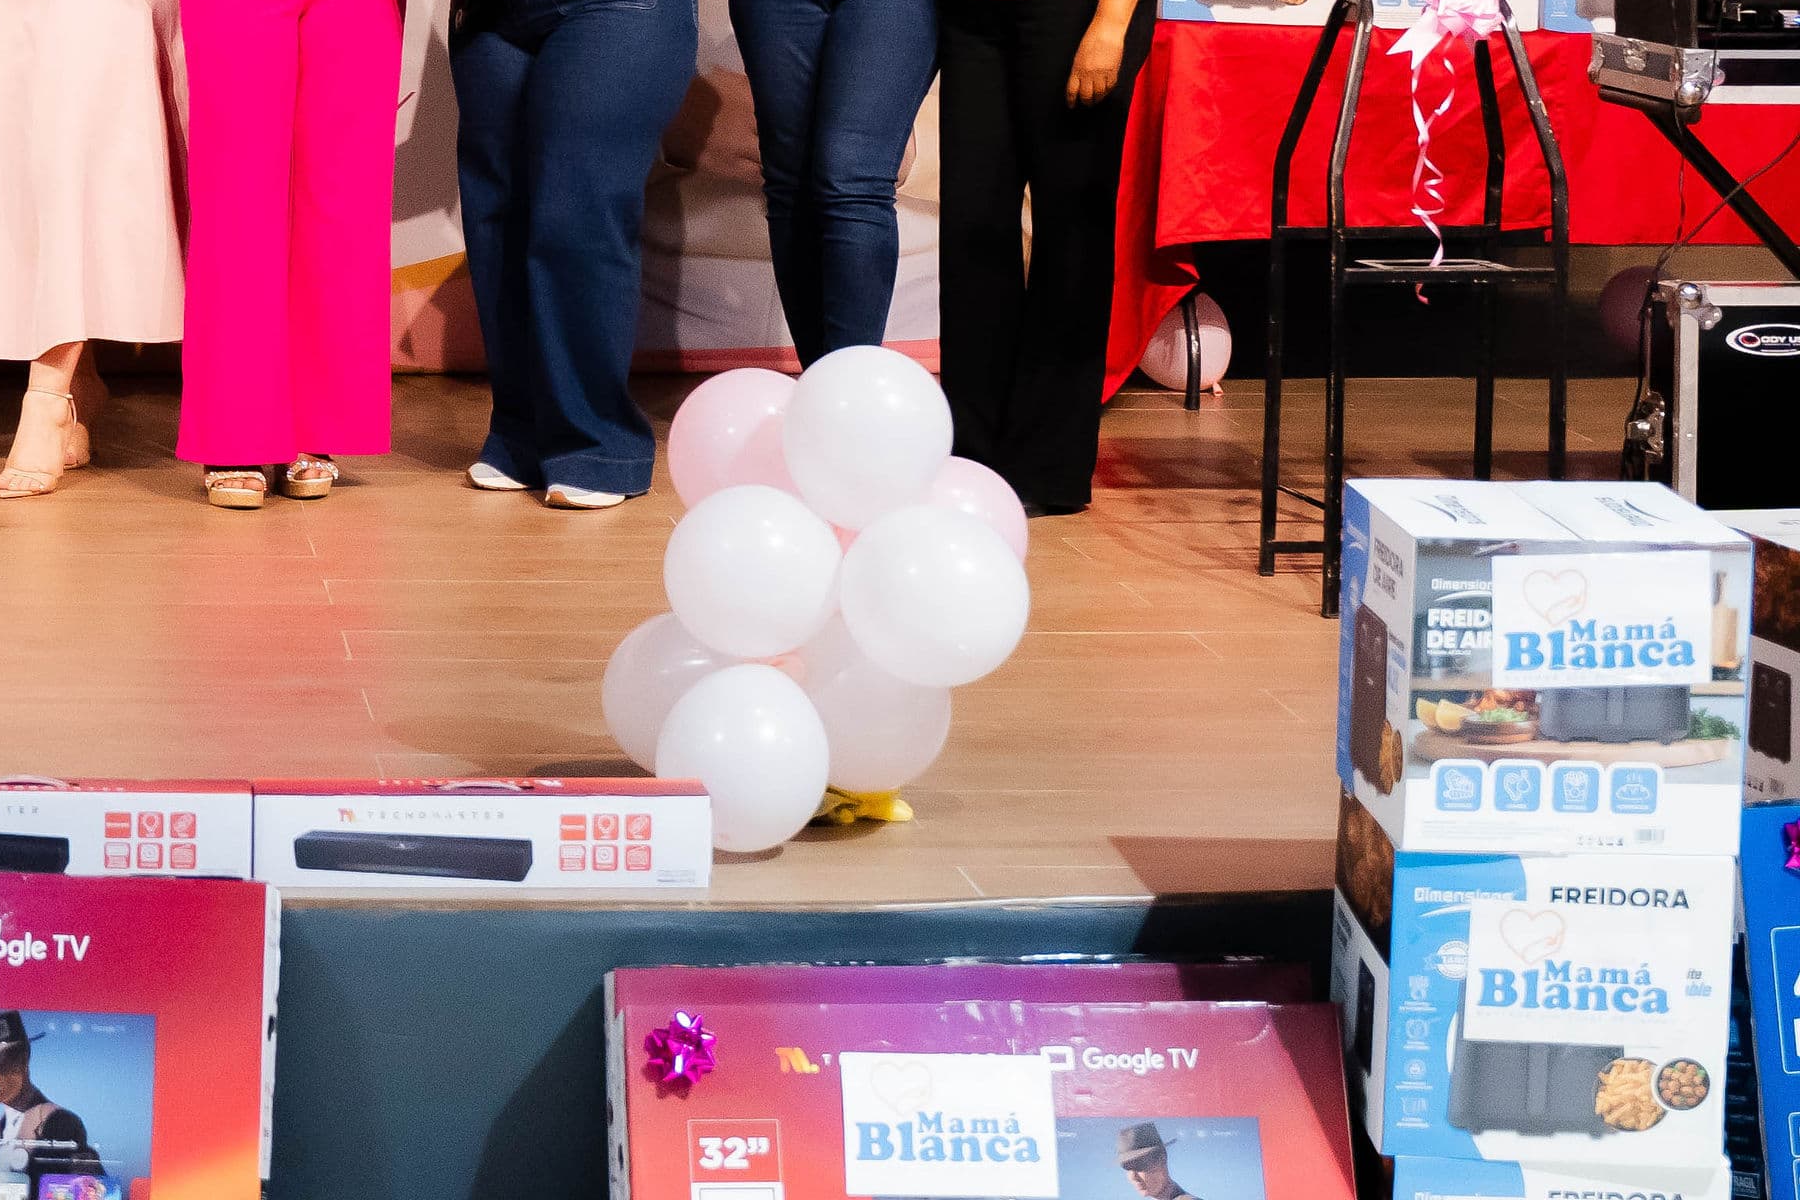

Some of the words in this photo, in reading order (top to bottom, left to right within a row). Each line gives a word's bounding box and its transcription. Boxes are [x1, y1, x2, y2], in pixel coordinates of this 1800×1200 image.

[1431, 578, 1492, 590] Dimension
[1427, 608, 1492, 627] FREID
[1569, 616, 1677, 642] Mamá
[1427, 630, 1457, 649] DE
[1504, 630, 1696, 671] Blanca
[1551, 887, 1689, 909] FREIDORA
[52, 935, 90, 962] TV
[1544, 959, 1651, 985] Mamá
[1477, 968, 1670, 1014] Blanca
[1082, 1047, 1165, 1075] Google
[1168, 1048, 1198, 1070] TV
[918, 1111, 1020, 1134] Mamá
[856, 1122, 1040, 1162] Blanca
